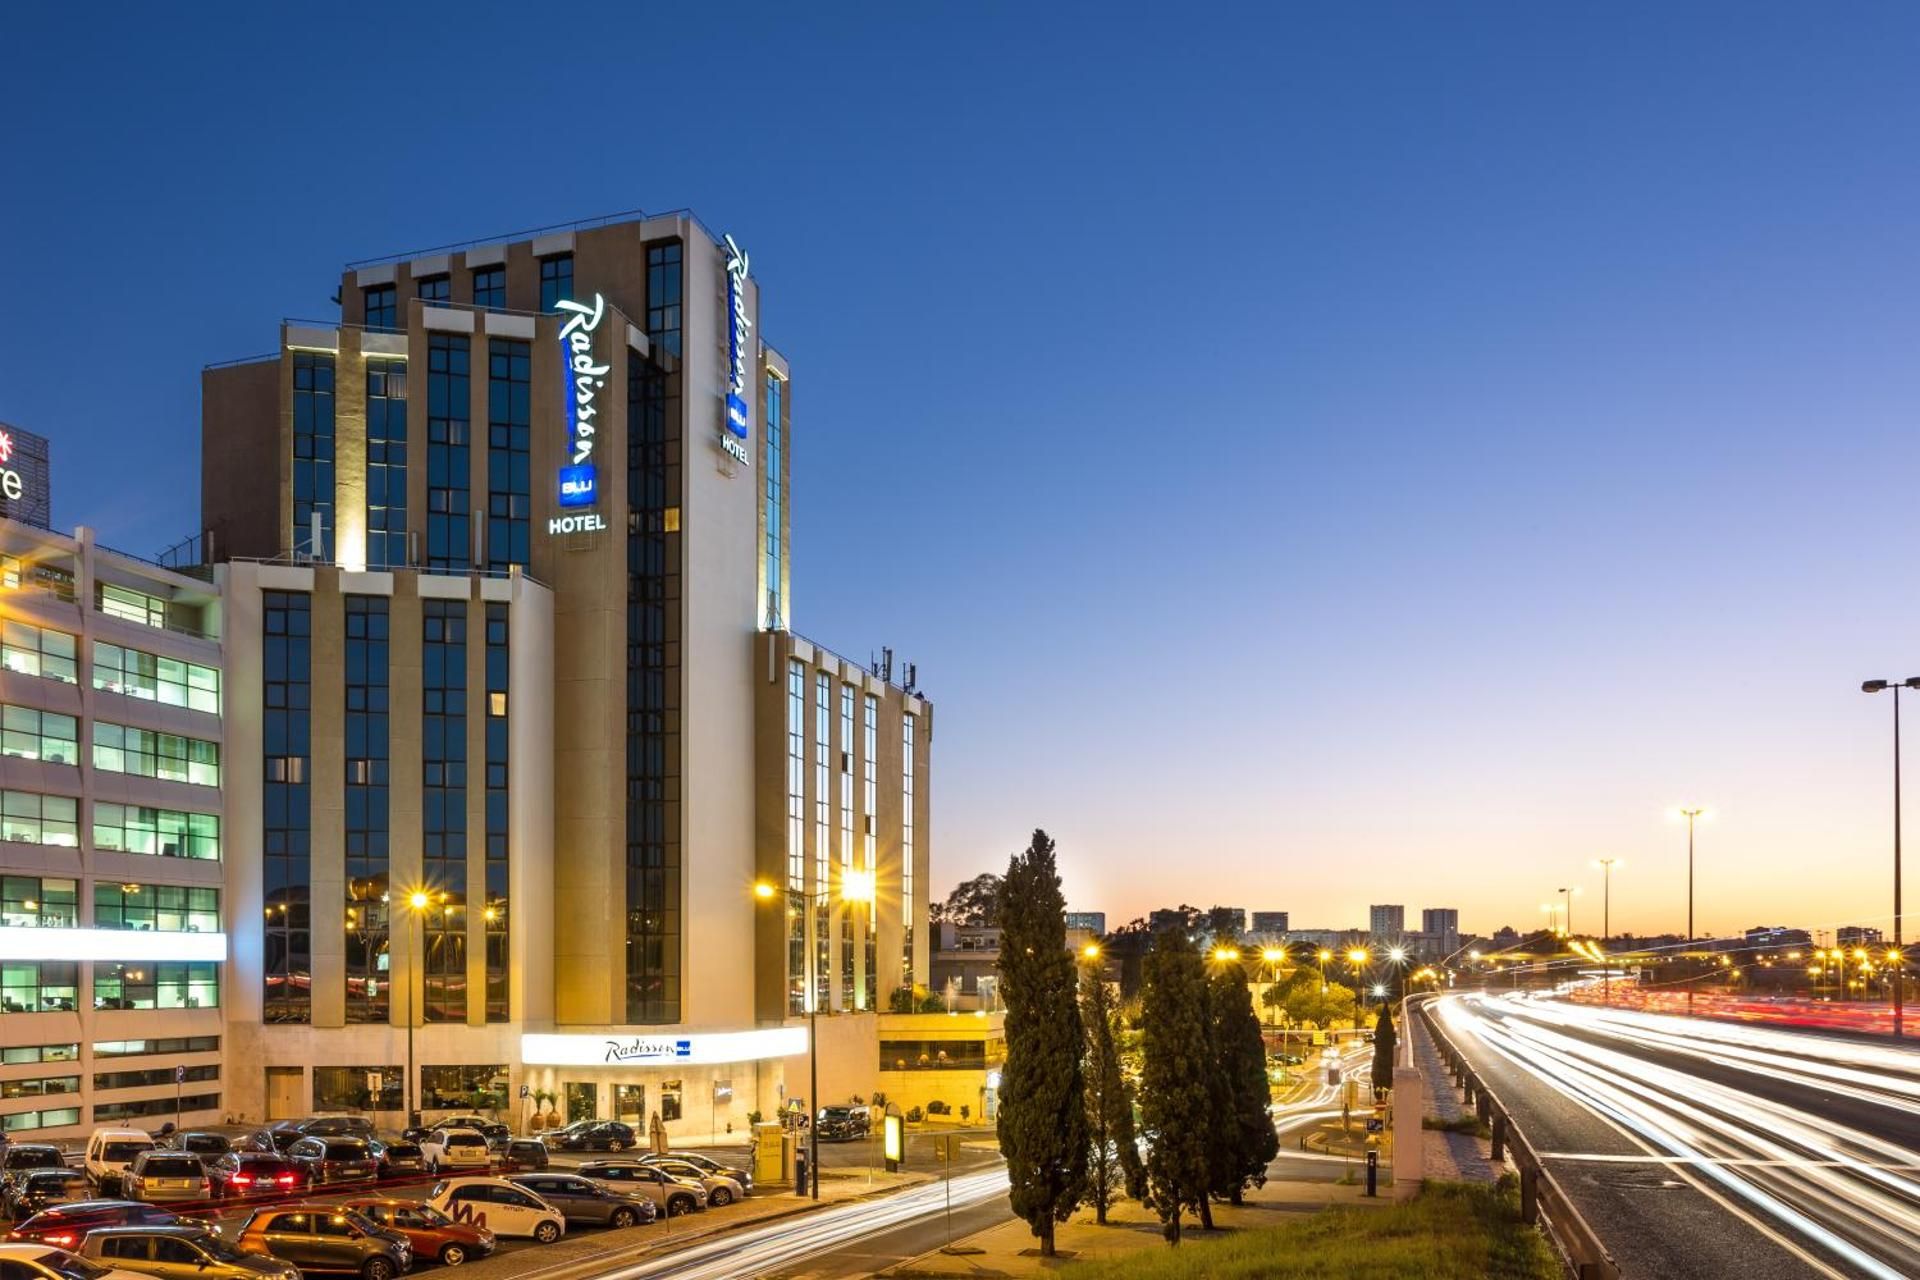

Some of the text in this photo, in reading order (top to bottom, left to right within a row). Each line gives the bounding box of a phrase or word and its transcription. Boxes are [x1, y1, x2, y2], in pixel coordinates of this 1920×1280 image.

[723, 233, 752, 395] Radisson
[555, 293, 610, 464] Radisson
[722, 434, 750, 466] HOTEL
[549, 515, 606, 534] HOTEL
[605, 1038, 674, 1062] Radisson
